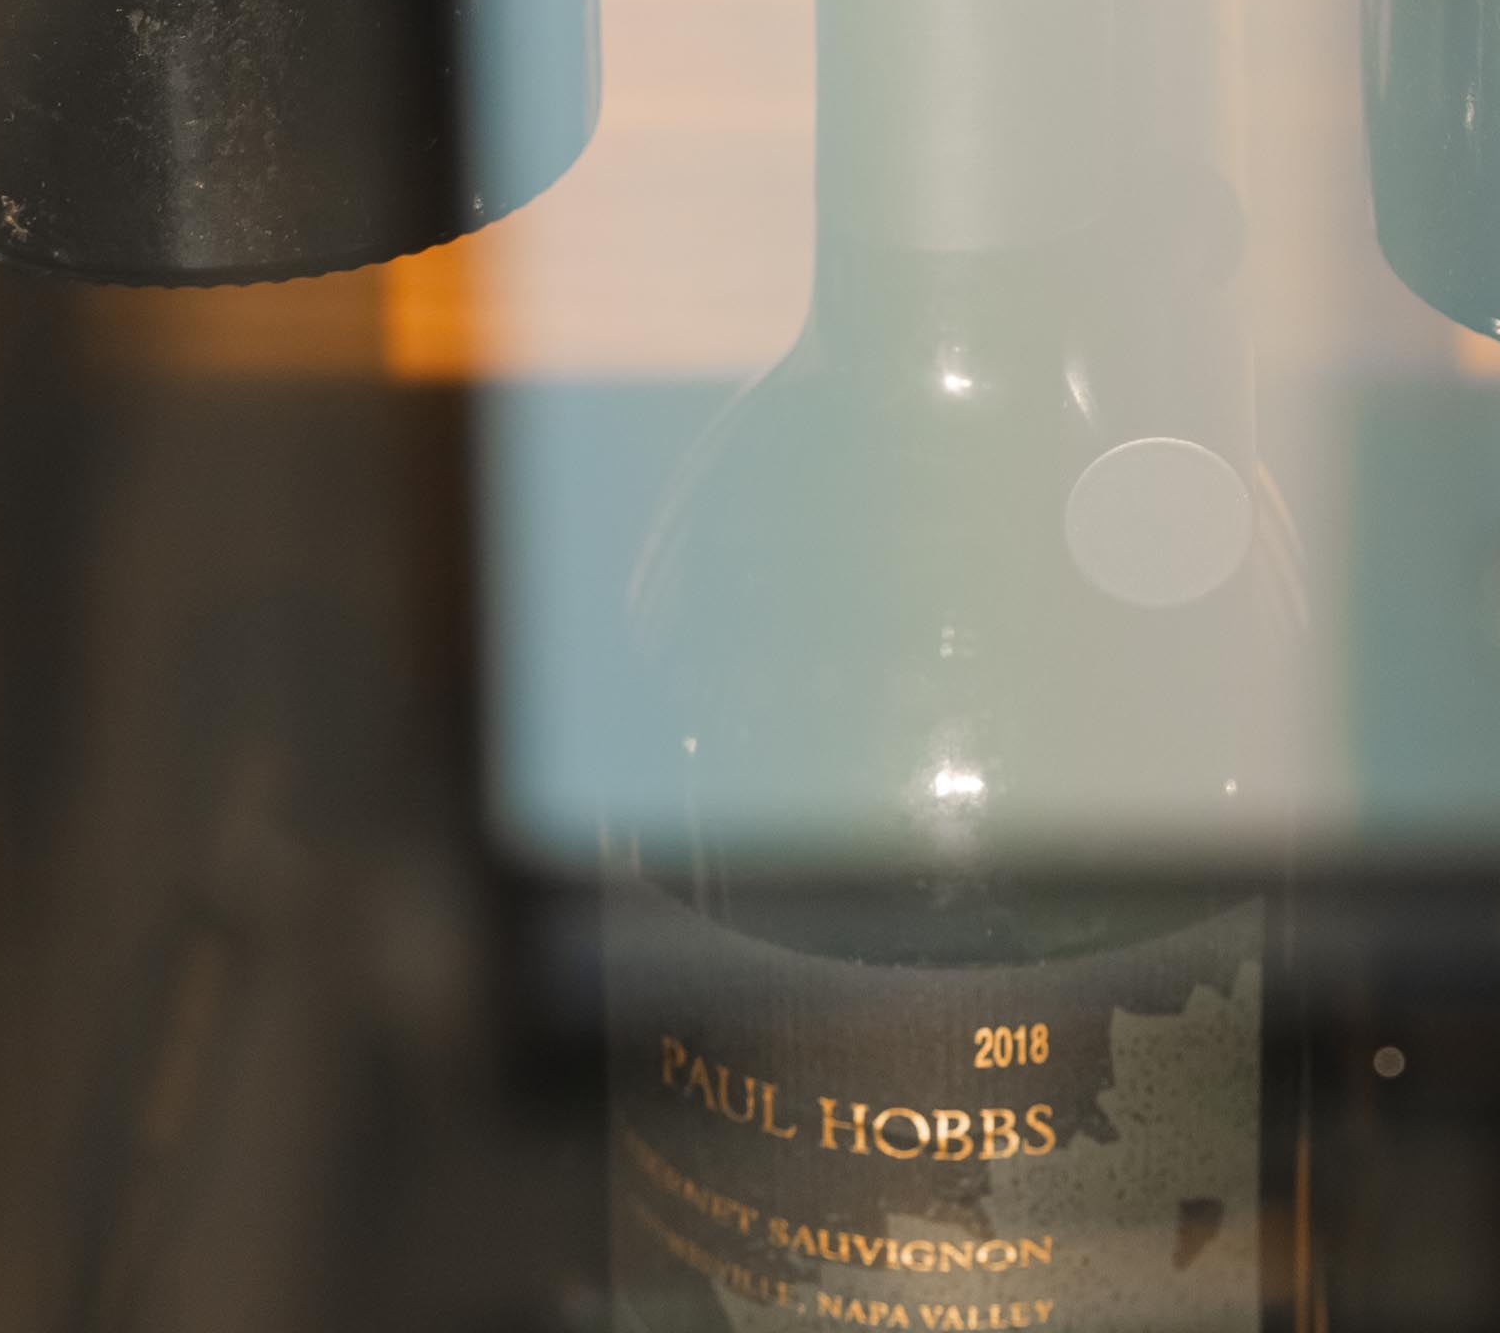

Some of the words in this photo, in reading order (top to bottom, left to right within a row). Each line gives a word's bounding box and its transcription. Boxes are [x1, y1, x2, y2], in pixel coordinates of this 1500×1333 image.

[974, 1023, 1049, 1070] 2018
[661, 1035, 797, 1140] PAUL
[818, 1095, 1056, 1163] HOBBS
[768, 1215, 1054, 1274] SAUVIGNON
[816, 1291, 911, 1330] NAPA
